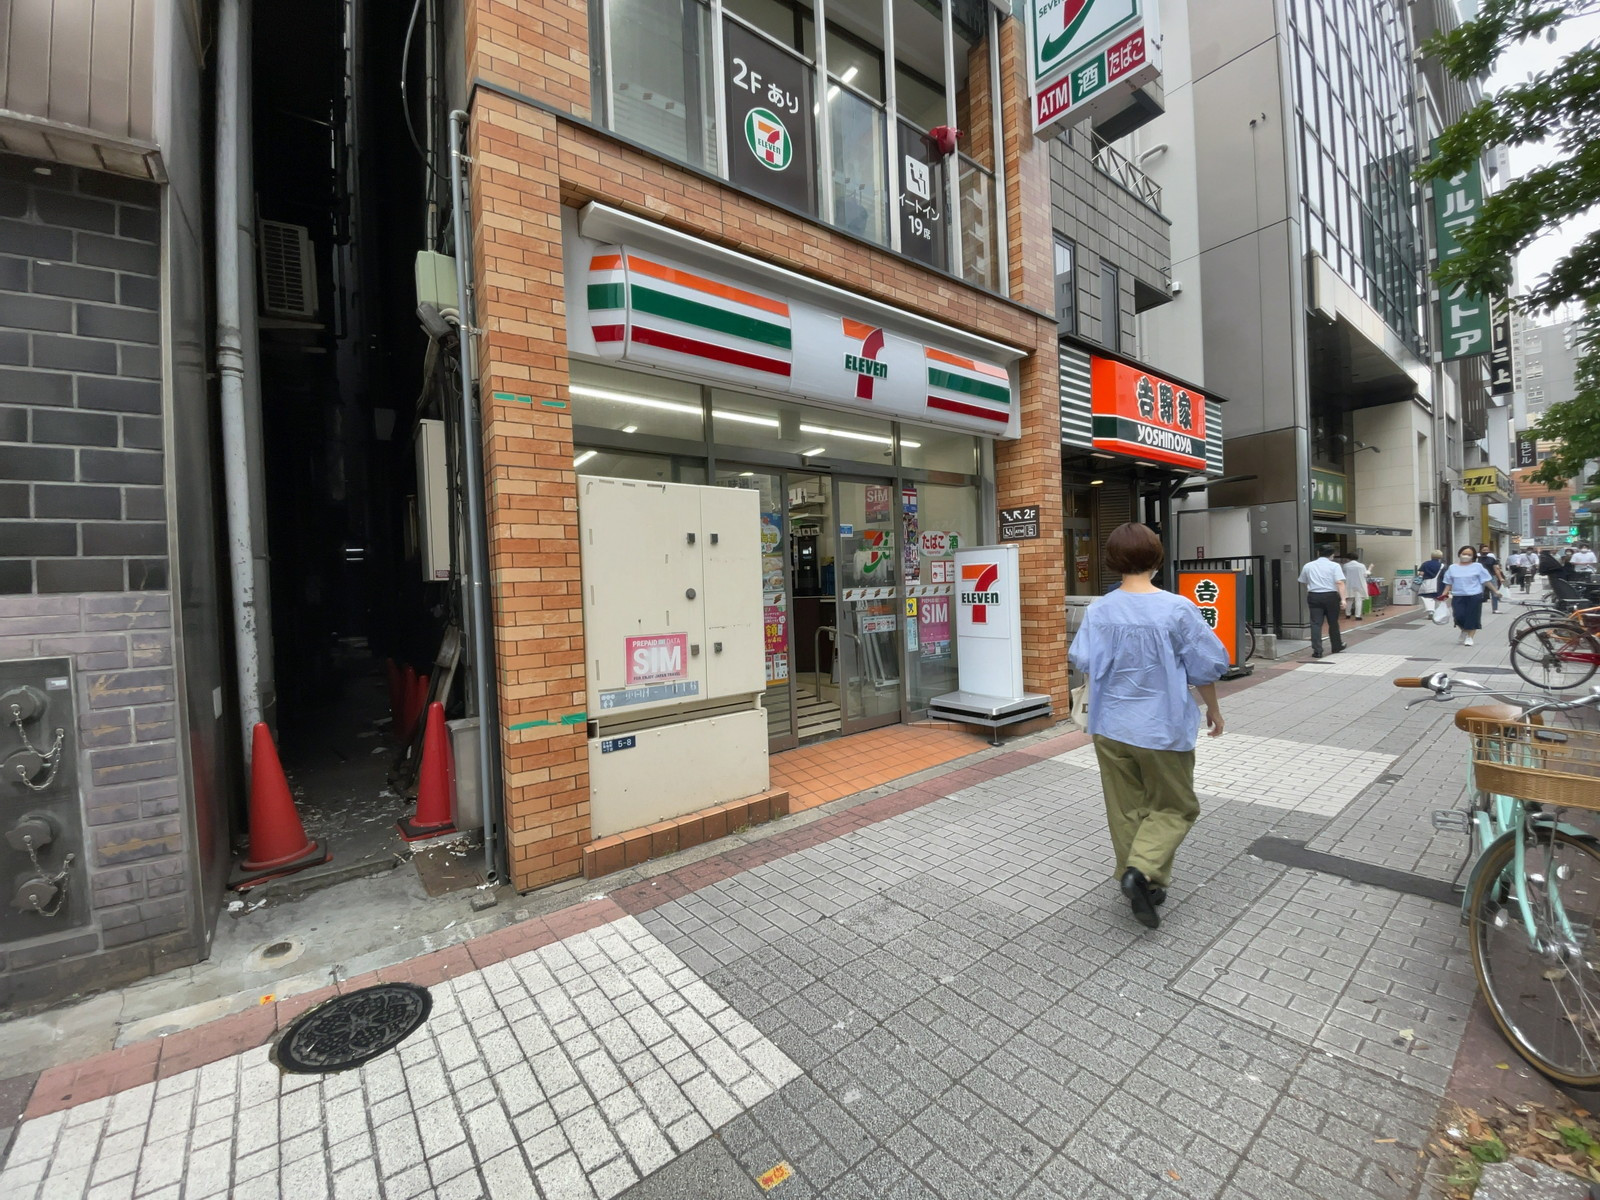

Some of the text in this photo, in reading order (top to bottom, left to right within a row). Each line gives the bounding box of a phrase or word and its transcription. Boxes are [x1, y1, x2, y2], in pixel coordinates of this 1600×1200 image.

[1109, 37, 1144, 77] たばこ
[733, 57, 799, 114] 2F あり
[1078, 62, 1099, 97] 酒
[1040, 83, 1068, 119] ATM
[899, 193, 940, 221] イートイン
[1136, 375, 1193, 431] 吉野家
[1137, 424, 1193, 454] YOSHINOYA
[866, 488, 888, 503] SIM
[1024, 508, 1036, 520] 2F
[922, 534, 959, 550] たばこ 酒
[921, 603, 948, 624] SIM
[632, 640, 658, 648] PREPAID
[633, 646, 681, 675] SIM
[618, 738, 632, 748] 5-8
